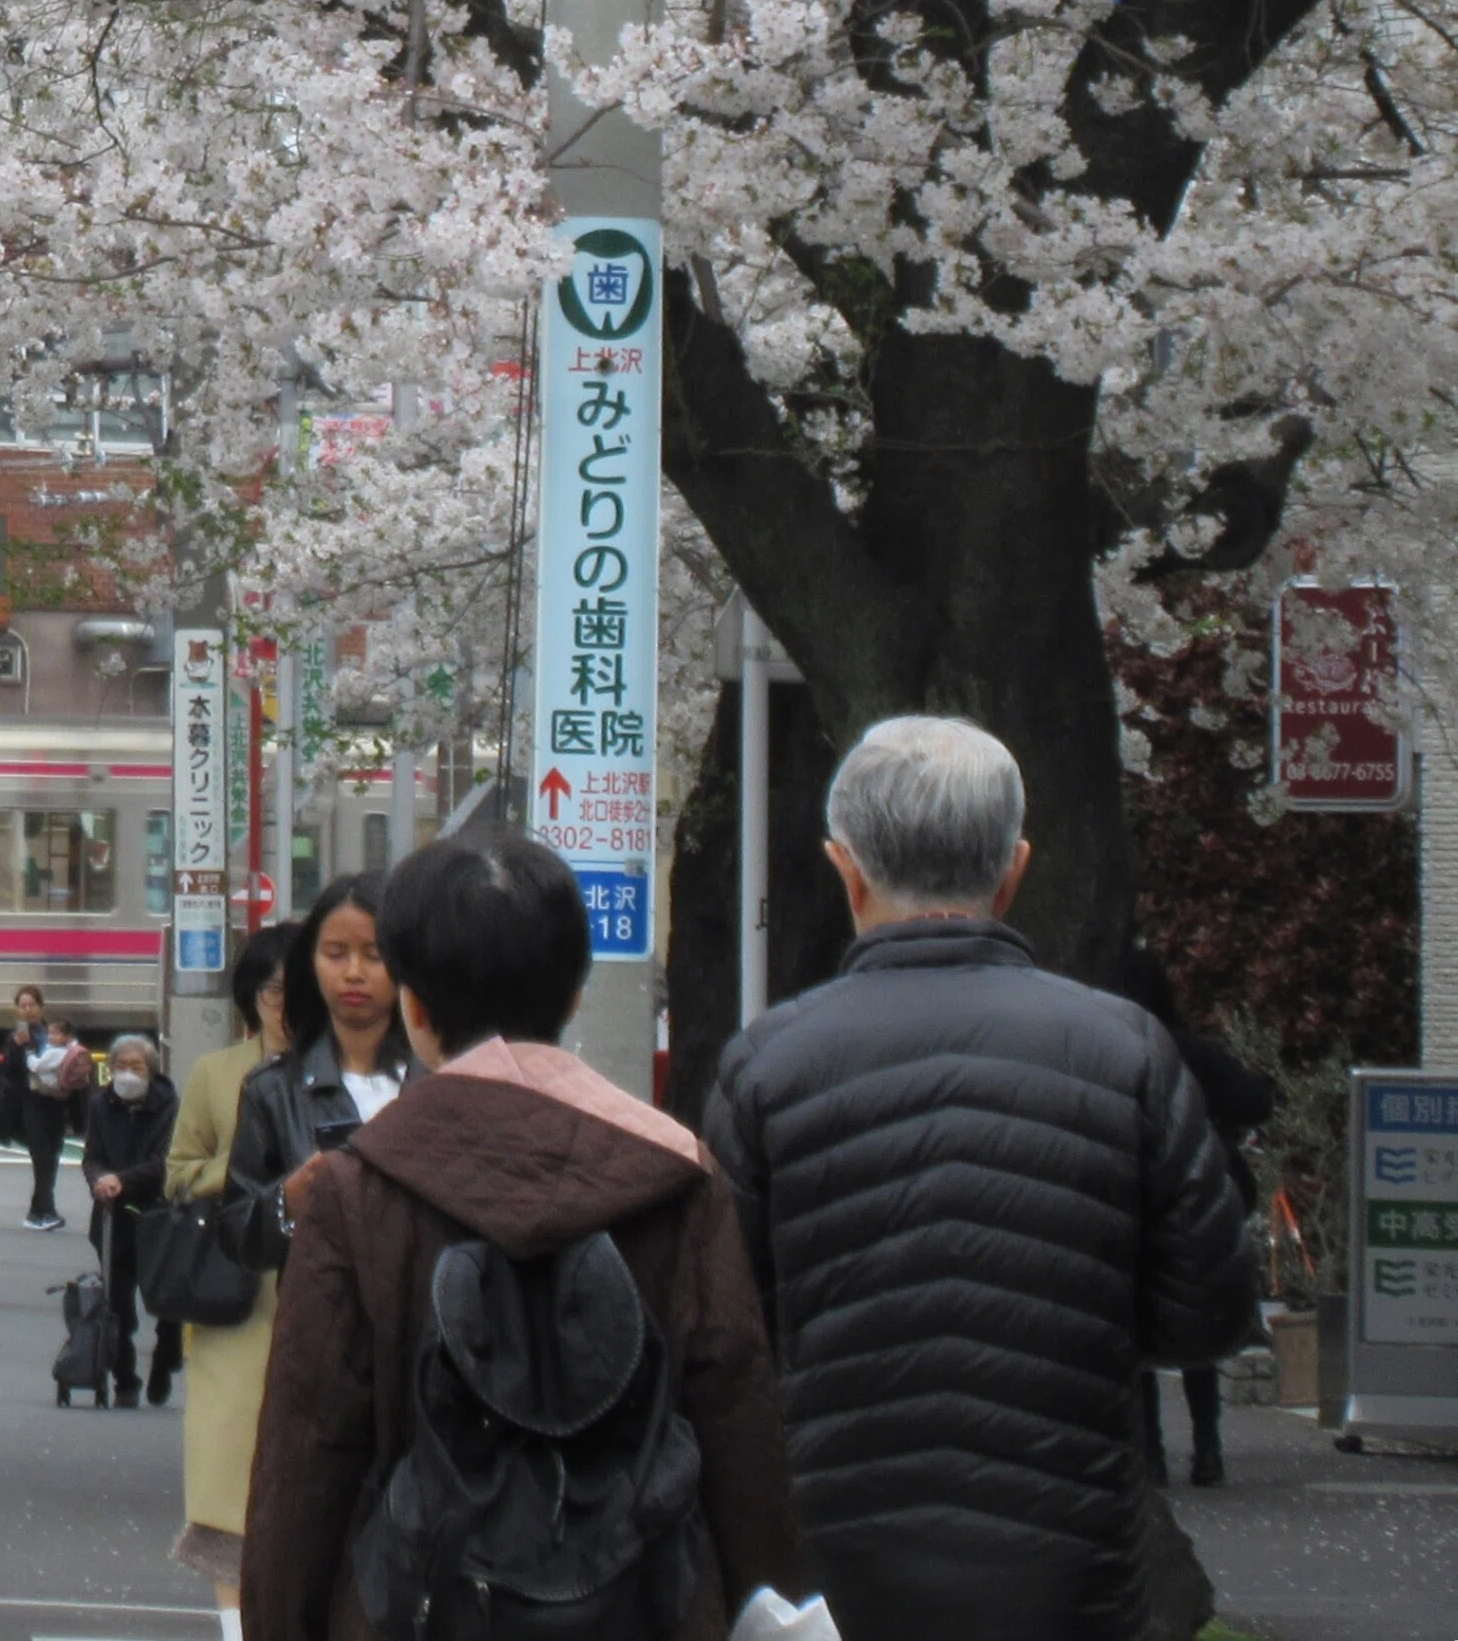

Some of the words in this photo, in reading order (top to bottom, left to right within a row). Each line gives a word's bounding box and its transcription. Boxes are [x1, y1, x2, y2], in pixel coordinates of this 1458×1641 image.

[588, 263, 629, 305] 歯
[568, 346, 643, 374] 上北沢
[570, 380, 632, 707] みどりの歯科
[550, 709, 644, 757] 医院
[187, 695, 213, 865] 木暮クリニック
[580, 770, 651, 796] 上北沢駅
[585, 884, 636, 910] 北沢
